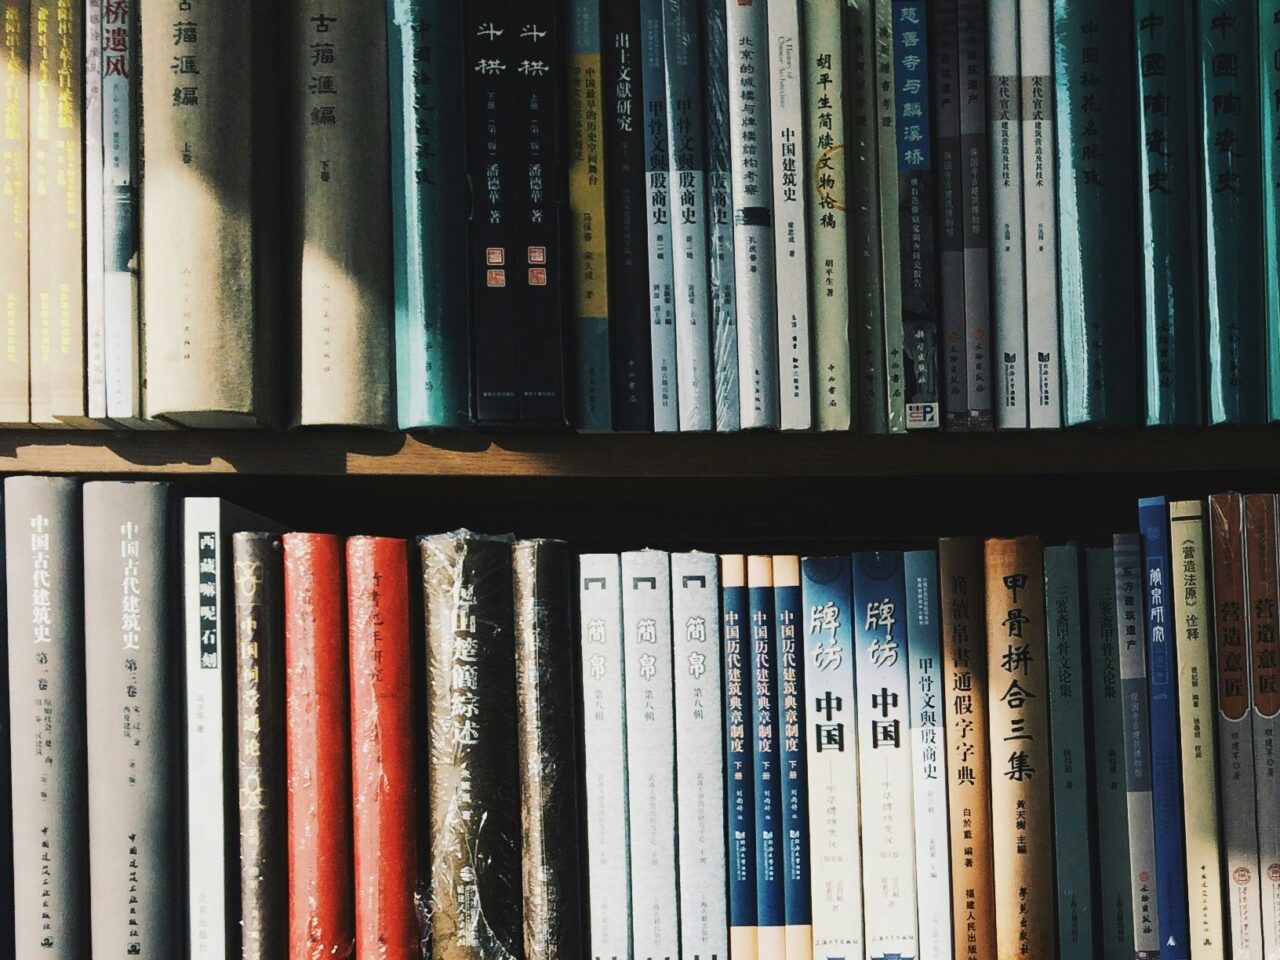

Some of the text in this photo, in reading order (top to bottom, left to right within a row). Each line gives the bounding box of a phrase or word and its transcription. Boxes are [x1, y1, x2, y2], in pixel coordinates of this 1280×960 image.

[781, 128, 796, 201] 中国建筑史
[816, 53, 837, 229] 胡平生简牍文物论稿
[30, 514, 52, 644] 中国古代建筑史
[120, 521, 141, 651] 中国古代建筑史
[1254, 599, 1277, 694] 营造意匠
[725, 610, 744, 752] 中国历代建筑典章制度
[753, 611, 772, 752] 中国历代建筑典章制度
[780, 610, 798, 752] 中国历代建筑典章制度
[809, 602, 844, 753] 牌坊 中国
[865, 599, 900, 751] 牌坊 中国
[919, 658, 937, 780] 甲骨文與殷商史
[1000, 574, 1036, 782] 甲骨拼合三集
